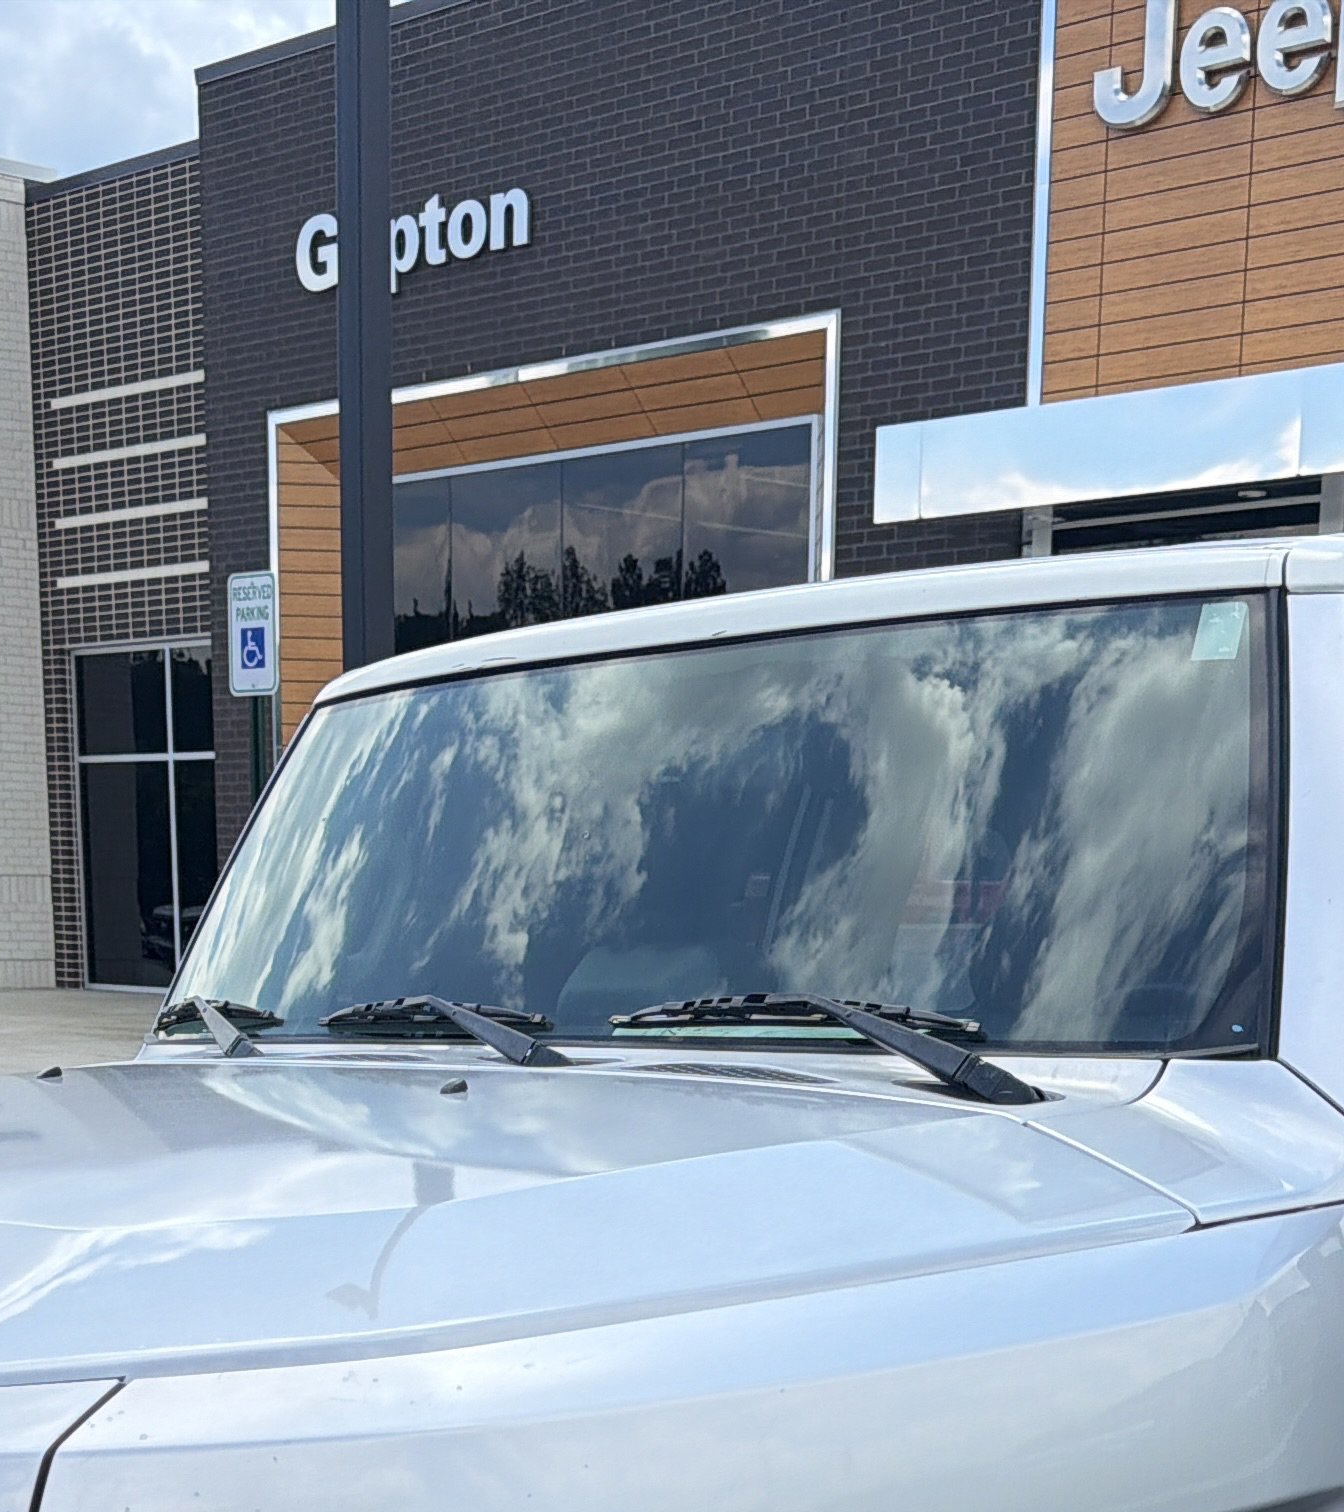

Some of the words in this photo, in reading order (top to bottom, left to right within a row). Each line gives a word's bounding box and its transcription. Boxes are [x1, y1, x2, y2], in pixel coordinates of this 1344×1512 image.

[296, 187, 529, 294] Gpton
[232, 583, 272, 601] RESERVED
[235, 604, 269, 622] PARKING
